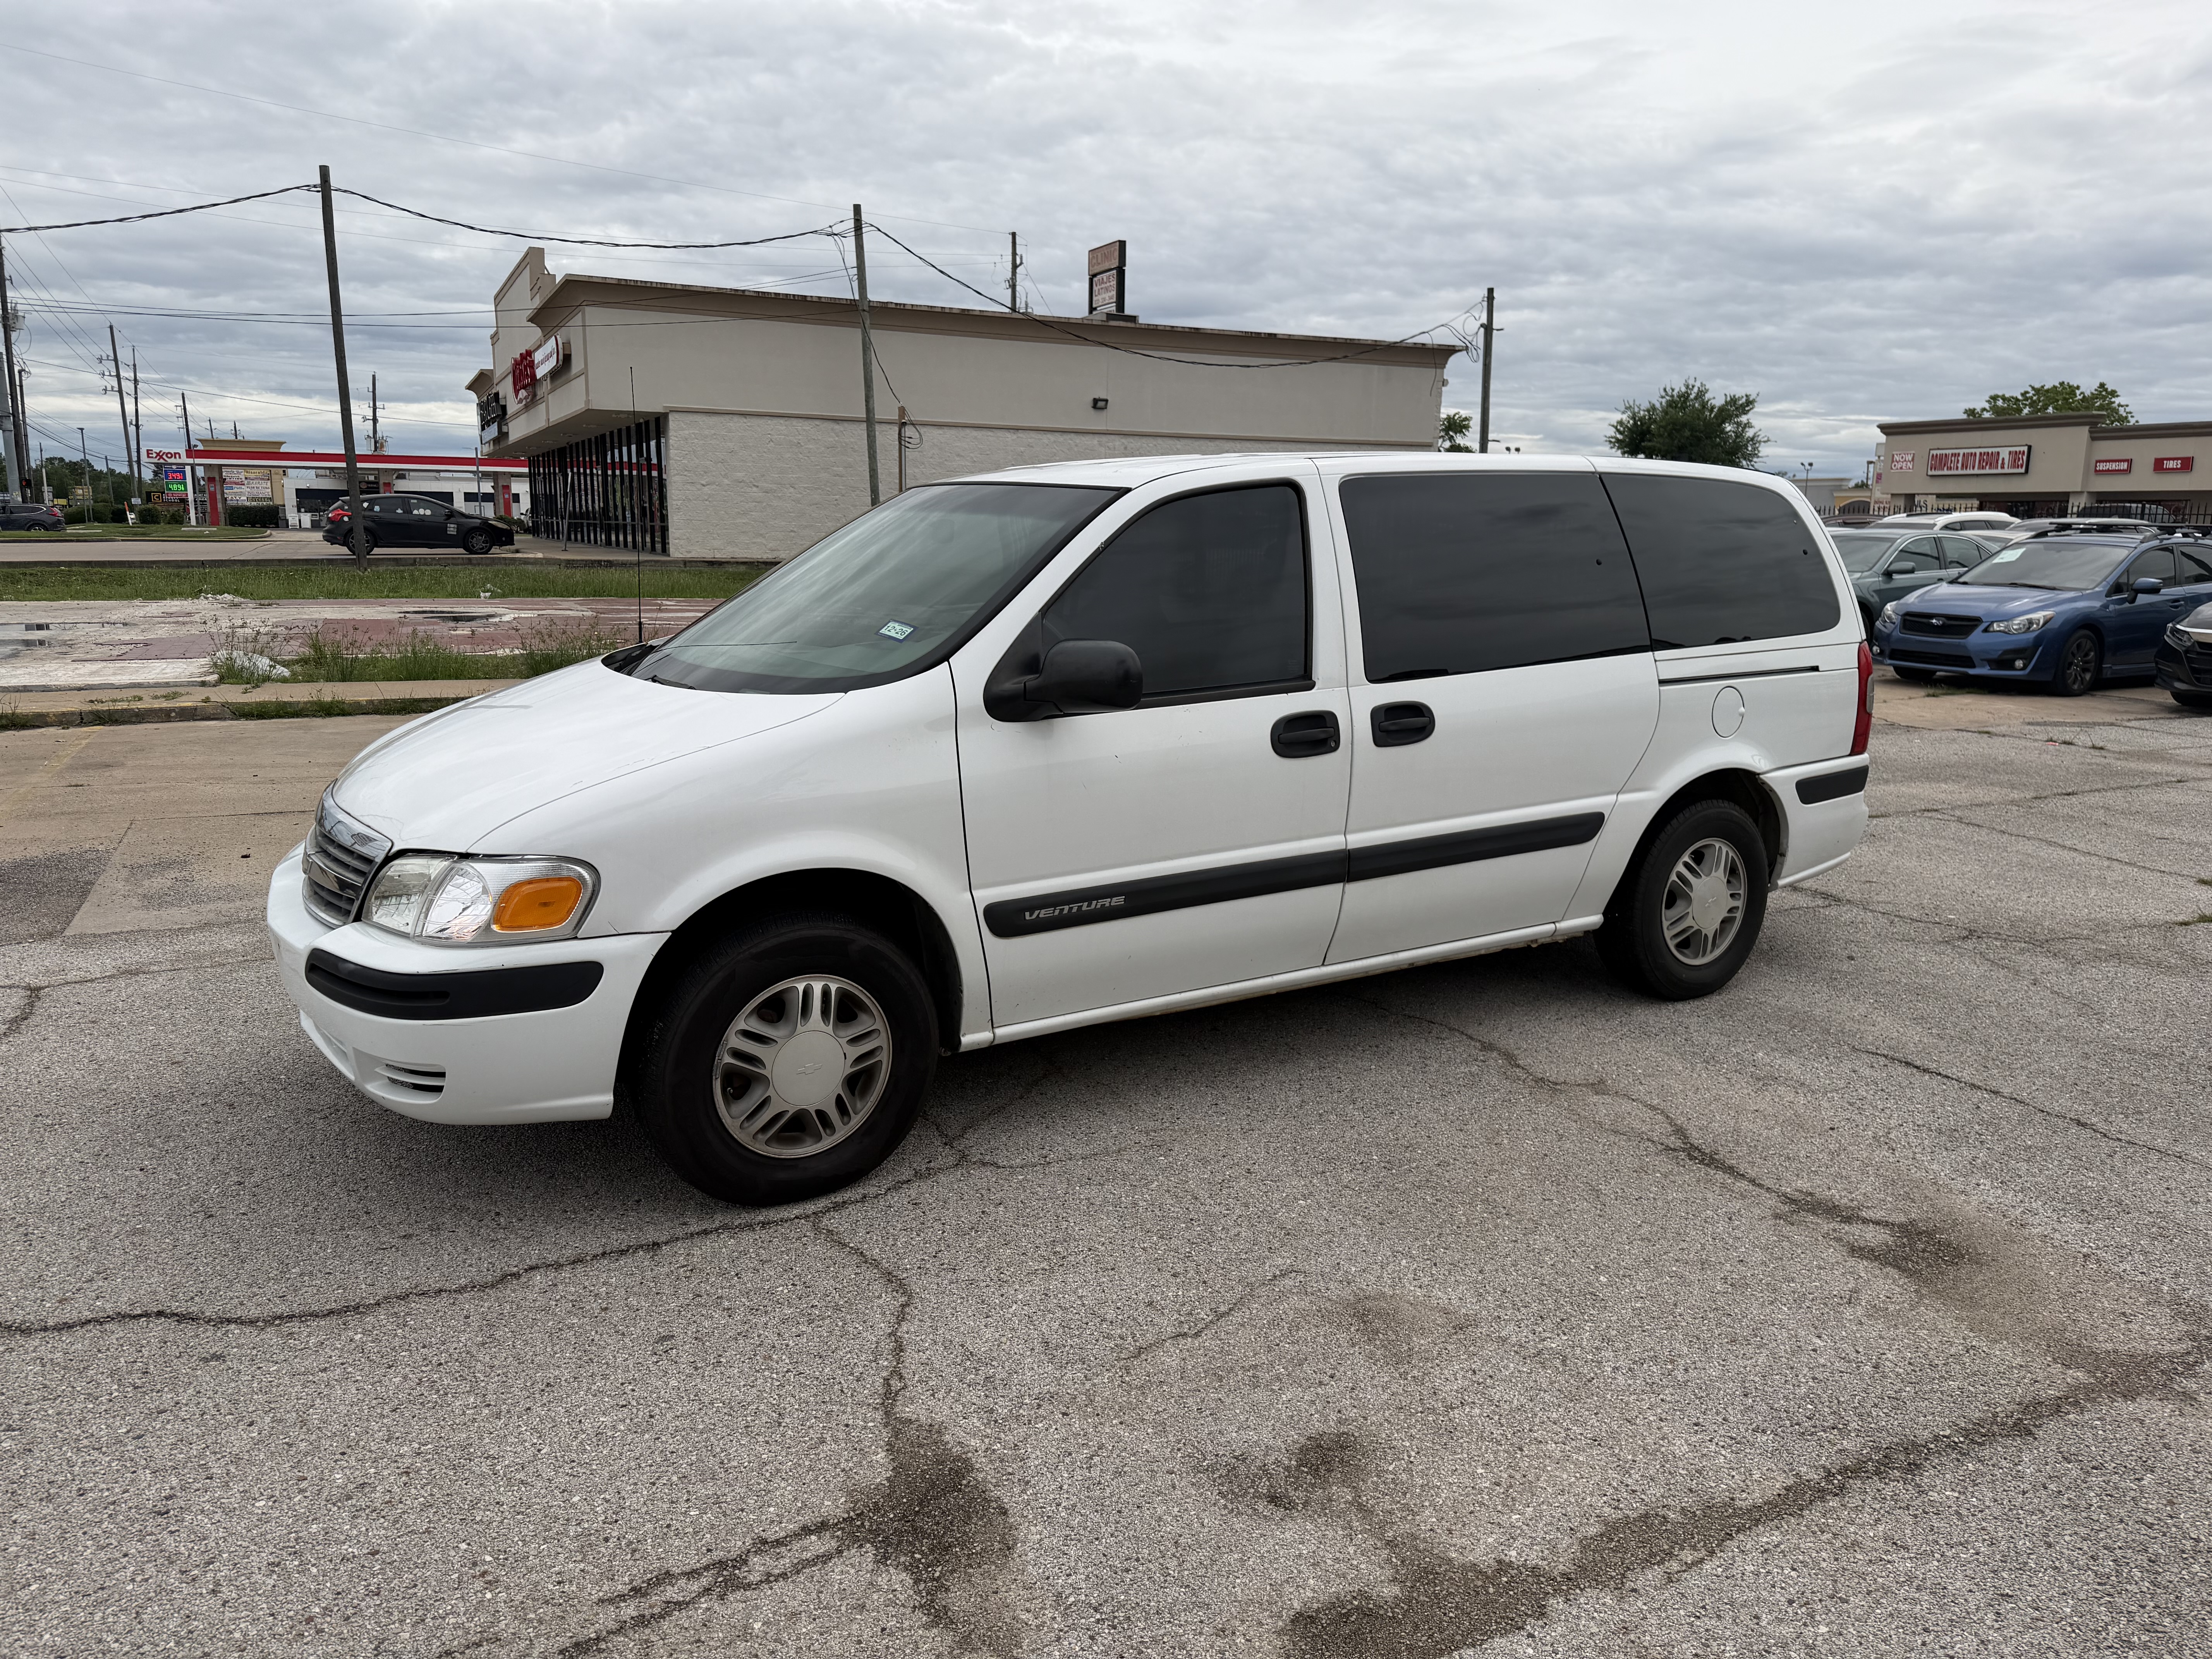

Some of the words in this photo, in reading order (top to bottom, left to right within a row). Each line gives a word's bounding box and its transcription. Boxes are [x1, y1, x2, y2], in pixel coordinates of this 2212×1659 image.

[1090, 248, 1117, 268] CLINIC
[1094, 273, 1115, 287] VIAJES
[1094, 283, 1115, 297] LATINOS
[146, 449, 182, 462] Exxon
[1930, 453, 1960, 471] COMPLETE
[1961, 452, 1977, 471] AUTO
[1977, 451, 2000, 470] REPAIR
[2000, 457, 2005, 469] &
[2007, 450, 2025, 469] TIRES
[1892, 462, 1913, 470] OPEN
[2096, 461, 2128, 471] SUSPENSION
[2163, 460, 2181, 469] TIRES
[895, 628, 908, 636] 26
[1025, 895, 1125, 921] VENTURE
